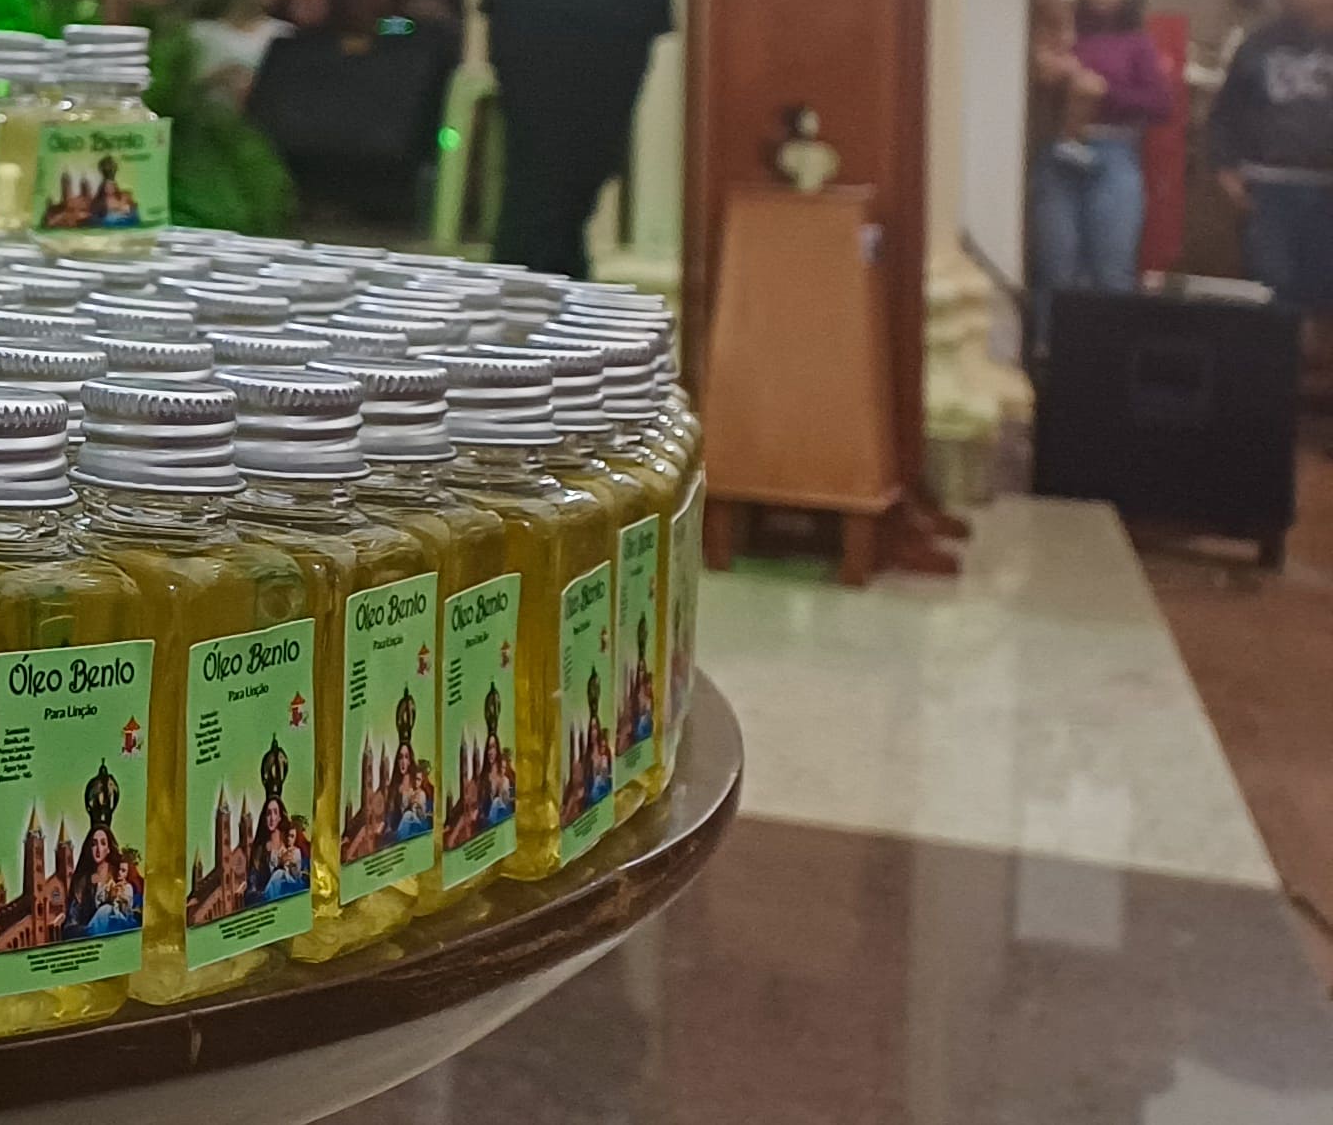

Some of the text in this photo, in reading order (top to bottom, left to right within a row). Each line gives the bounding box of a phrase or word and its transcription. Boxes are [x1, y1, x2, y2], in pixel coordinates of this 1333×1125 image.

[355, 591, 427, 632] Óleo Bento
[8, 654, 134, 697] Óleo Bento
[203, 638, 300, 682] Óleo Bento
[44, 707, 65, 720] Para
